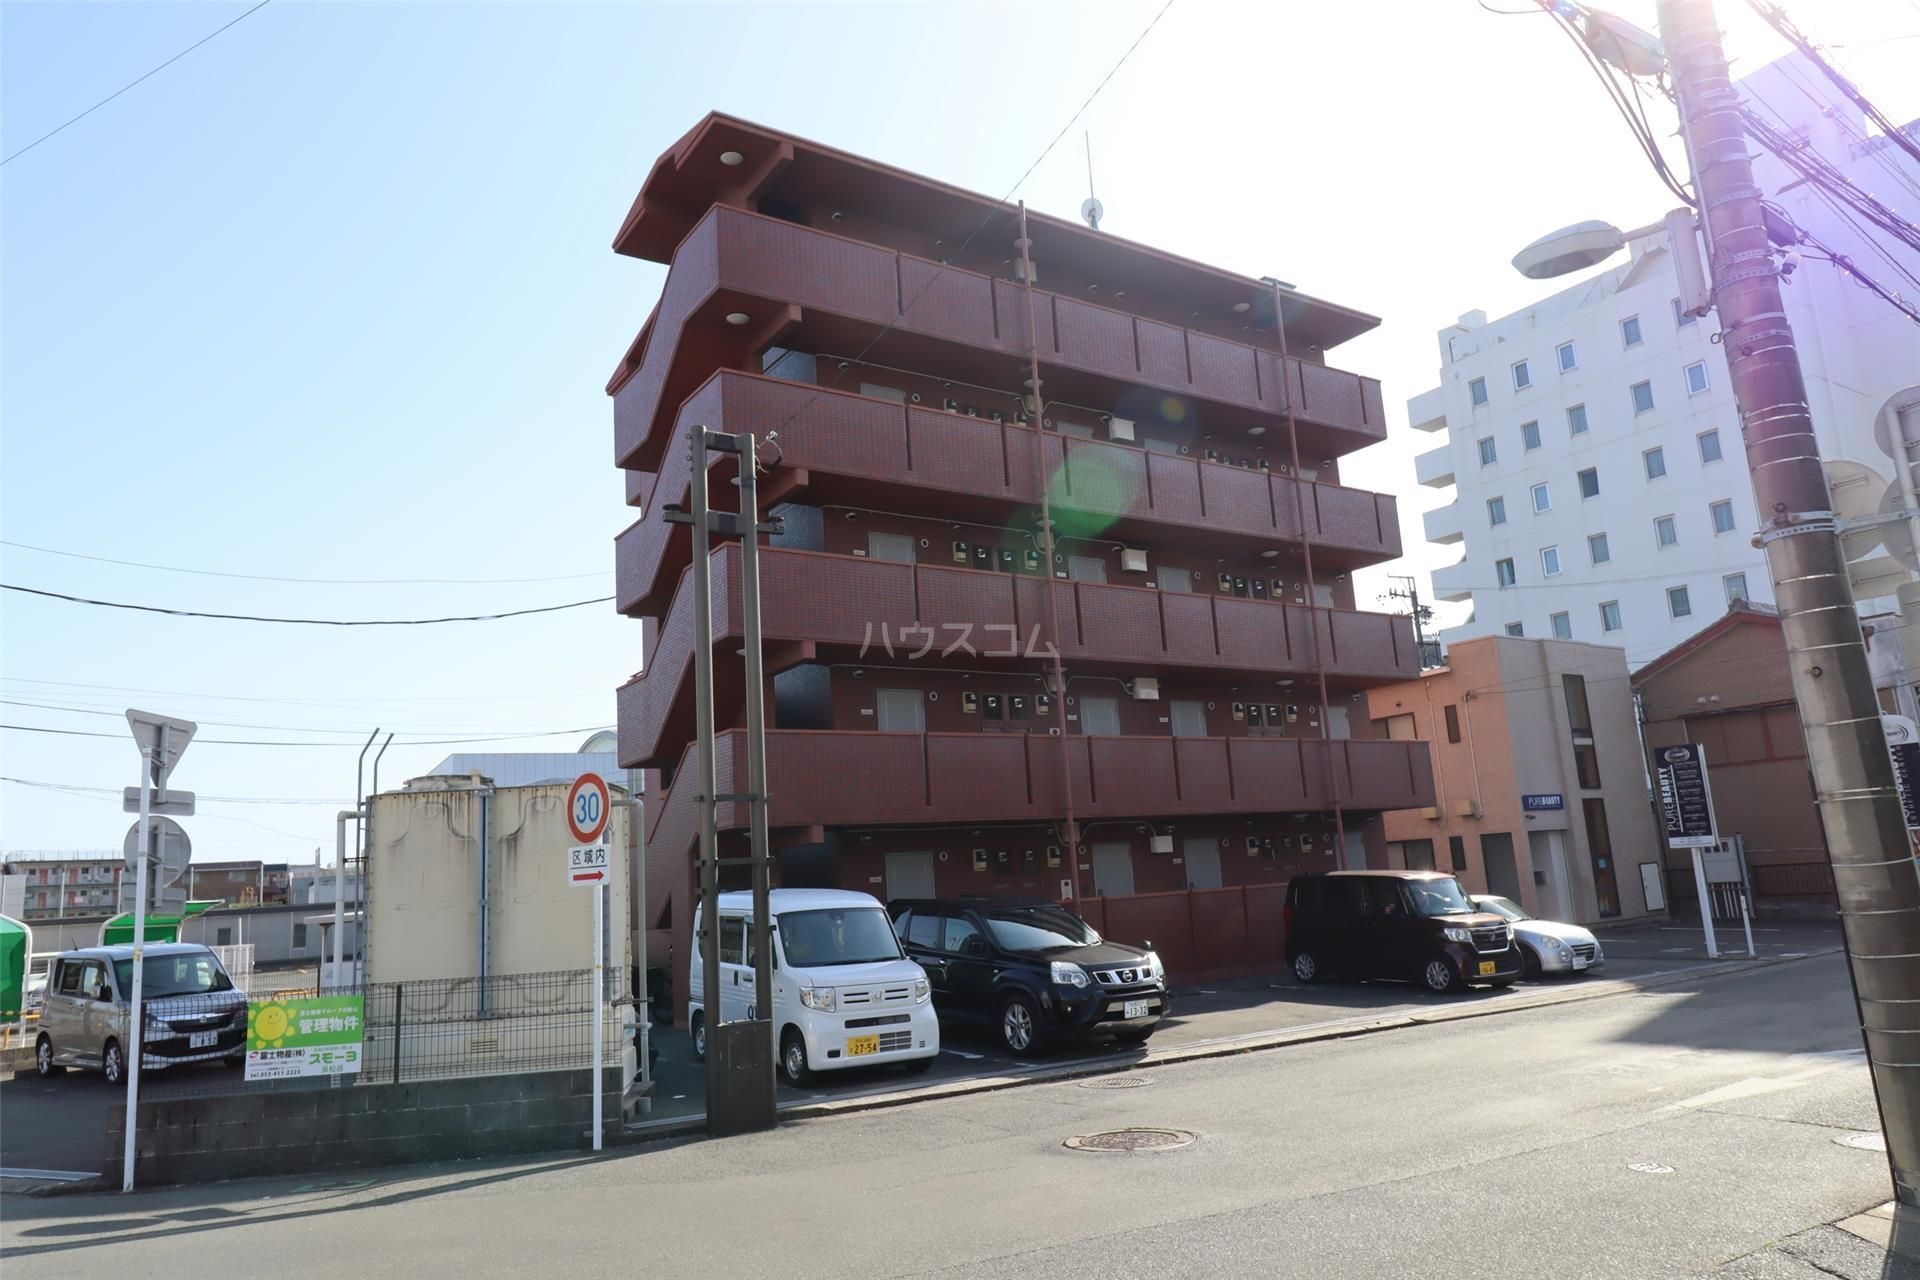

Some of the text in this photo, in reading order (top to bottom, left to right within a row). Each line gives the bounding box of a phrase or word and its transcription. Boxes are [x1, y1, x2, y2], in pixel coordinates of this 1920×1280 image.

[576, 792, 599, 824] 30
[573, 849, 605, 865] 区域内
[299, 1016, 359, 1034] 管理物件
[309, 1050, 357, 1065] スモーヨ
